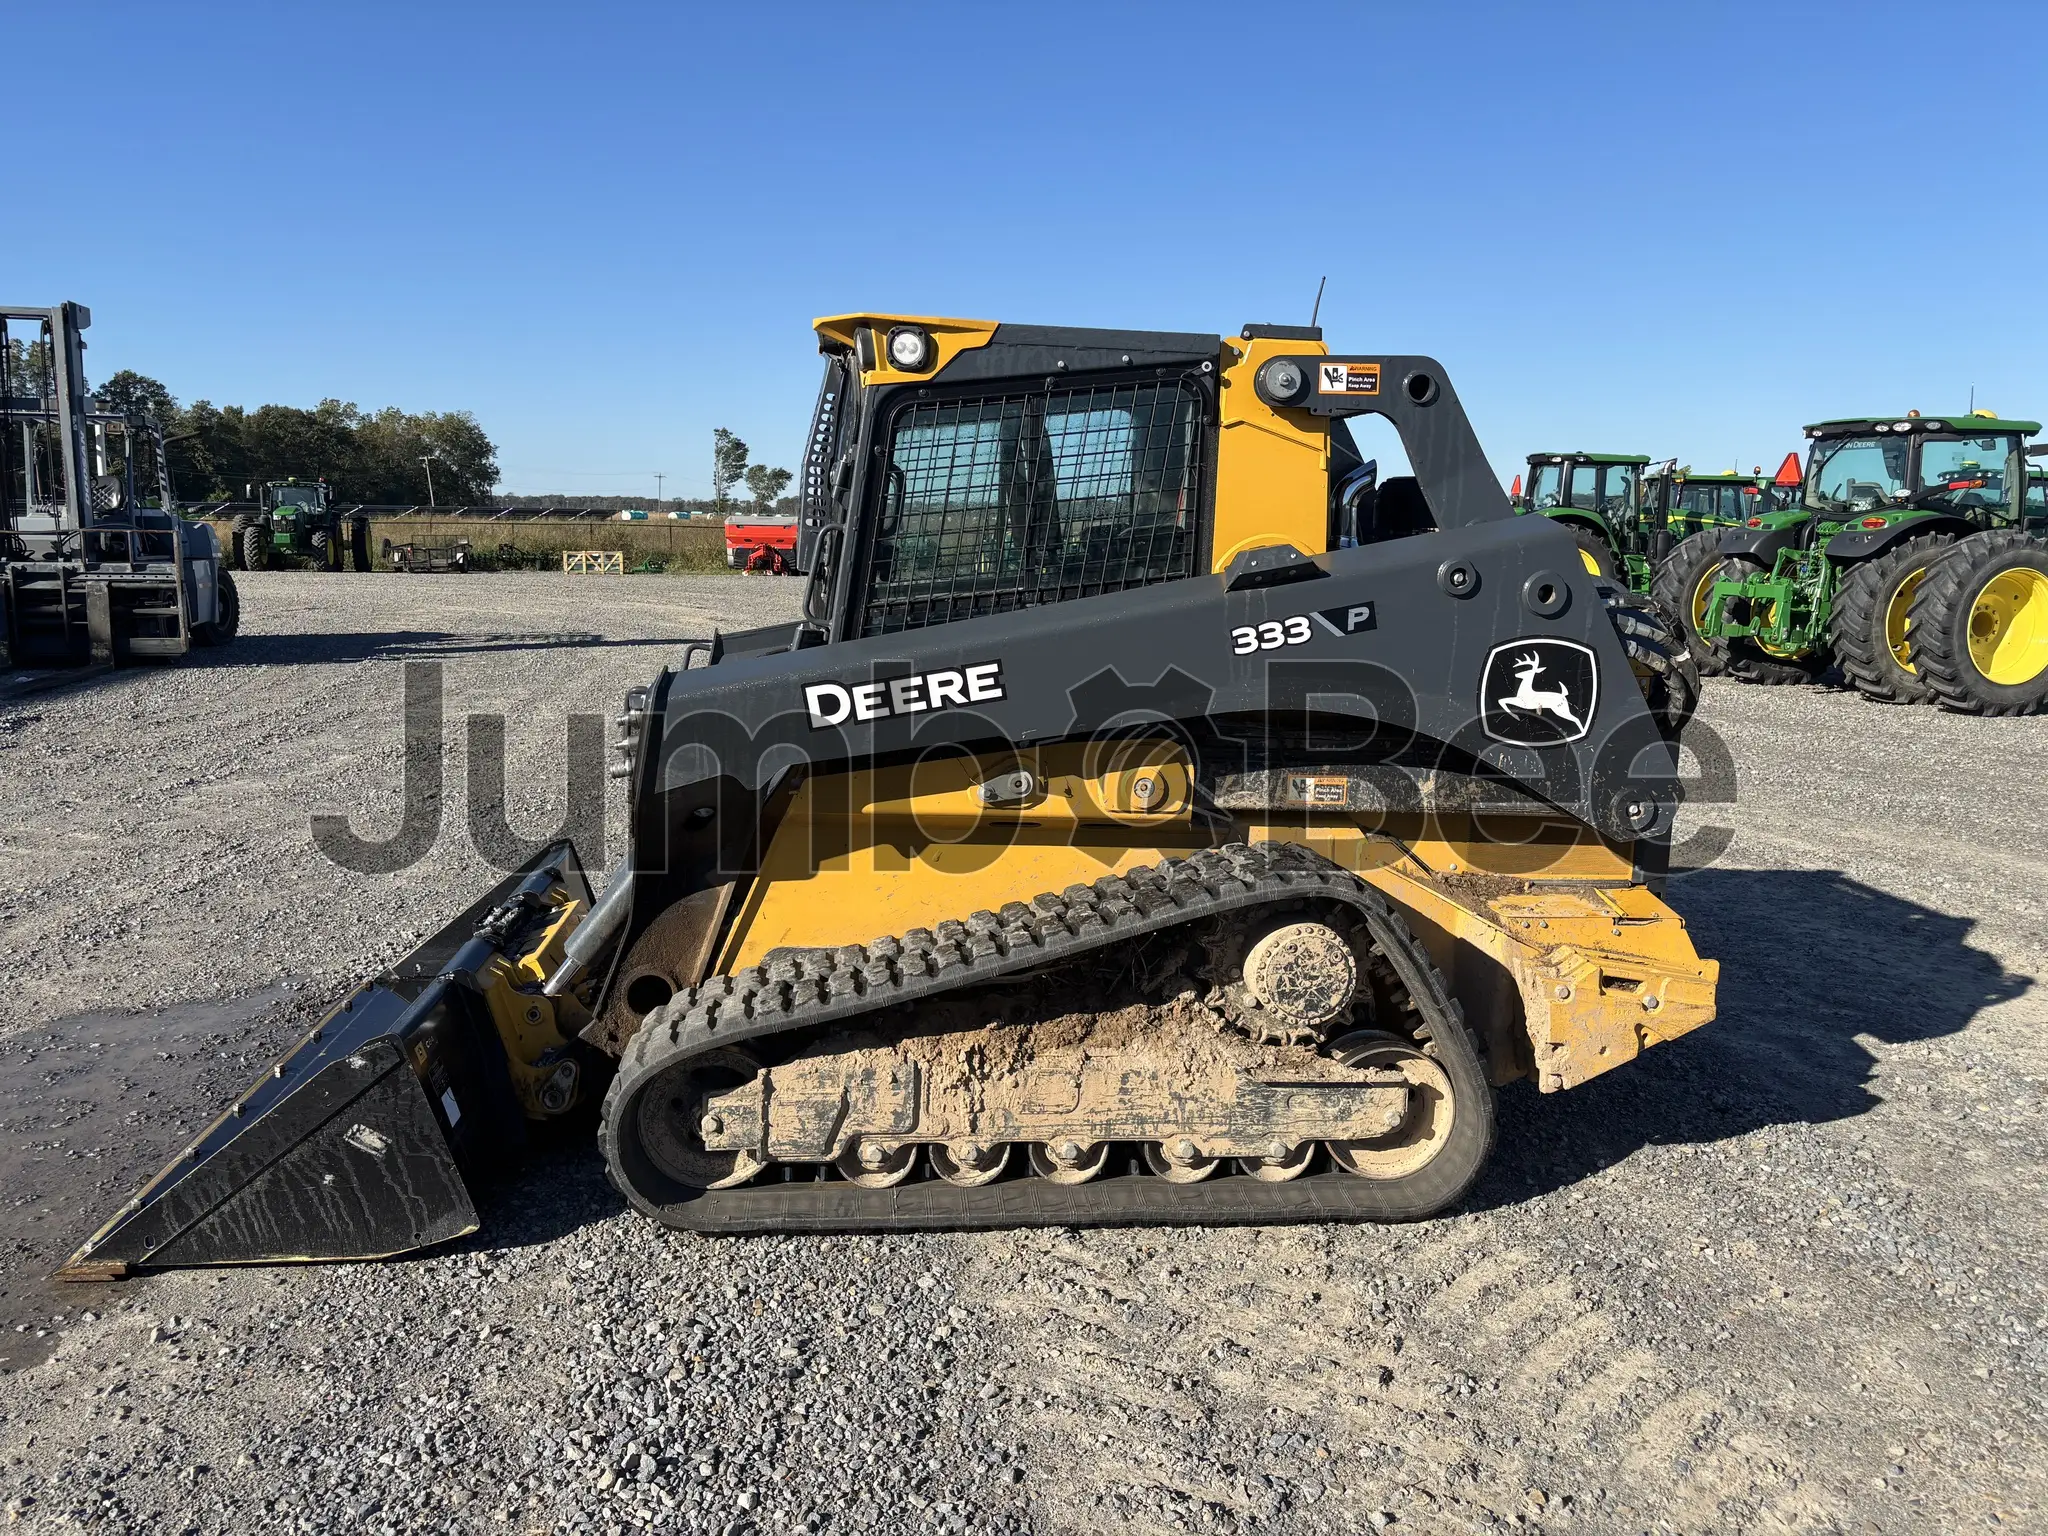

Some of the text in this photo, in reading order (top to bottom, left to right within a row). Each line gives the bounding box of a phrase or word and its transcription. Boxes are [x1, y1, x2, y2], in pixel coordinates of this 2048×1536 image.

[1231, 606, 1370, 655] 333 P
[804, 663, 1003, 729] DEERE
